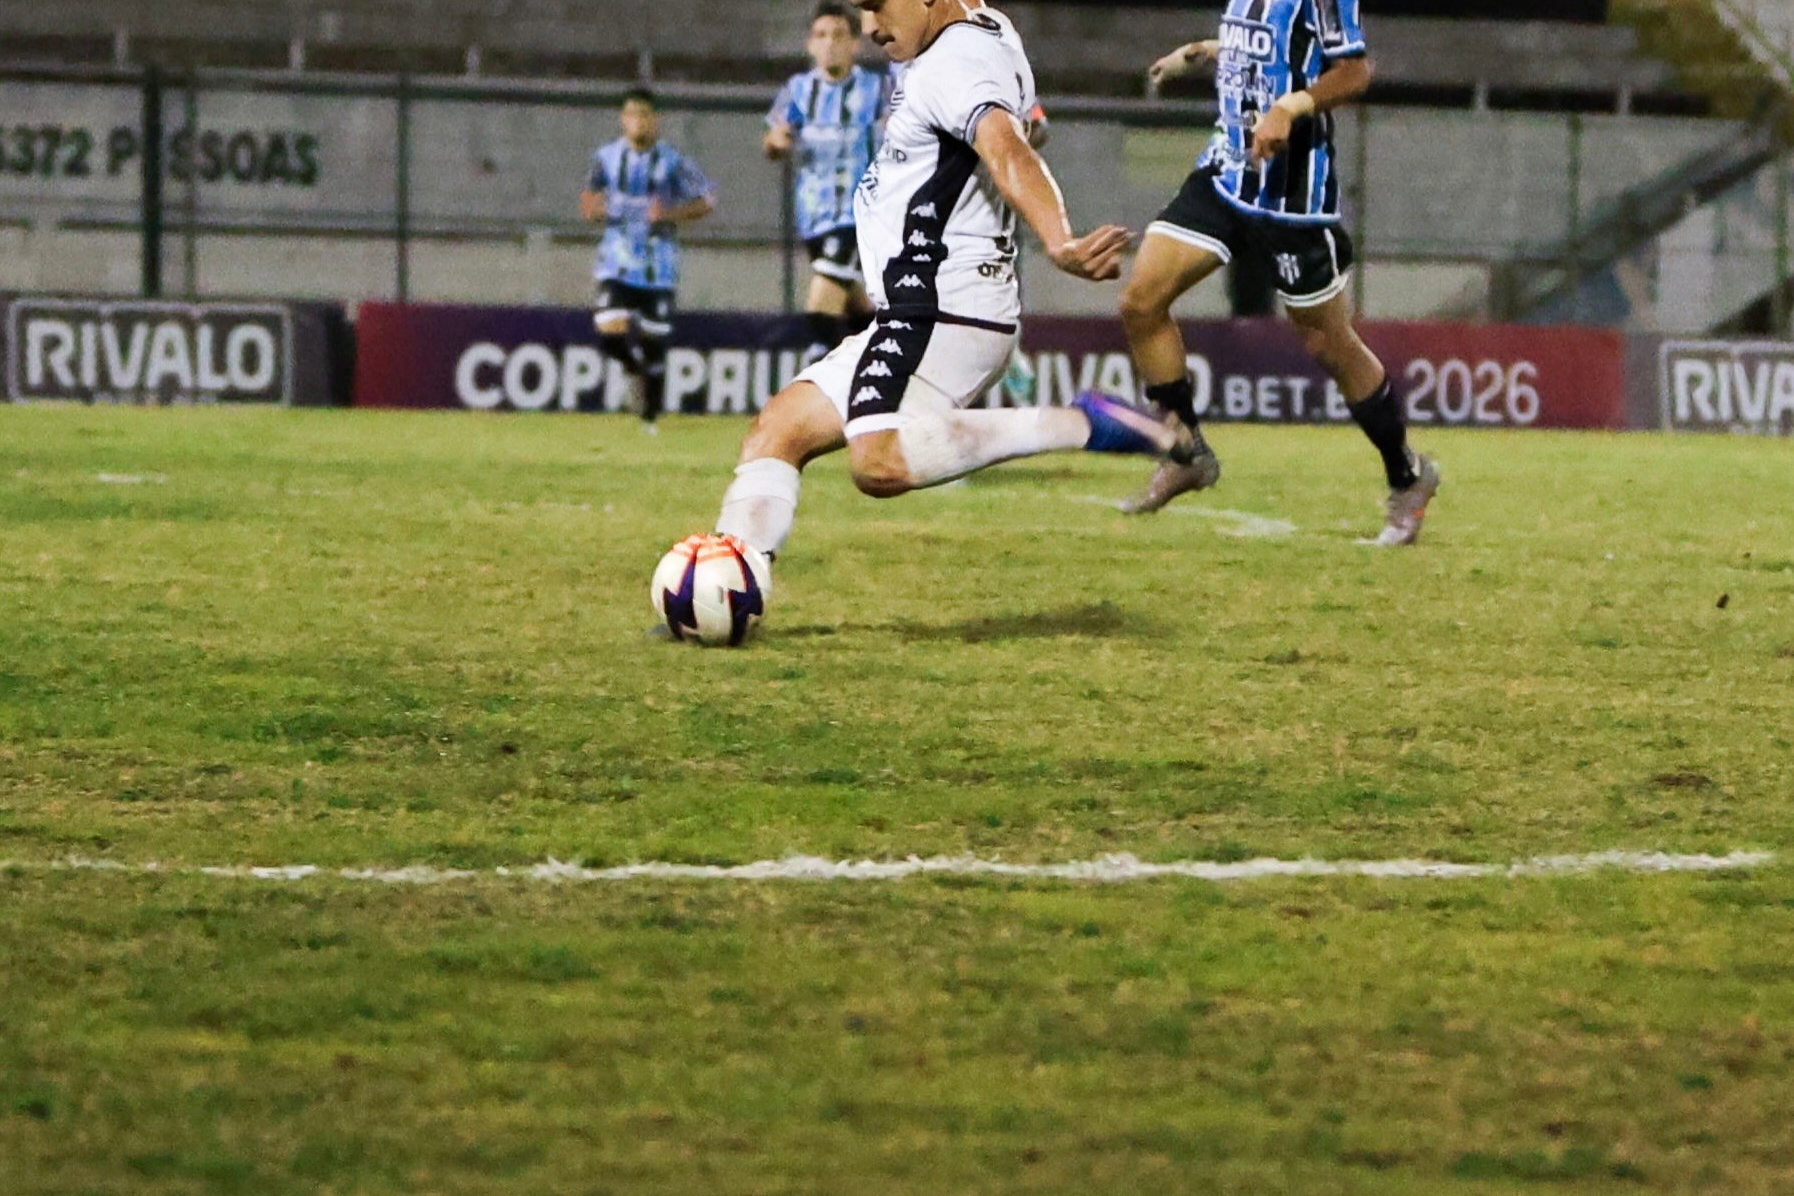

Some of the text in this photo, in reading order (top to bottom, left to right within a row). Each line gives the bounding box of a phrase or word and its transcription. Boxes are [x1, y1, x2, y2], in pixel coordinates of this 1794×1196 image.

[0, 123, 319, 186] 372 PSSOAS
[25, 317, 275, 392] RIVALO
[1403, 357, 1541, 425] 2026
